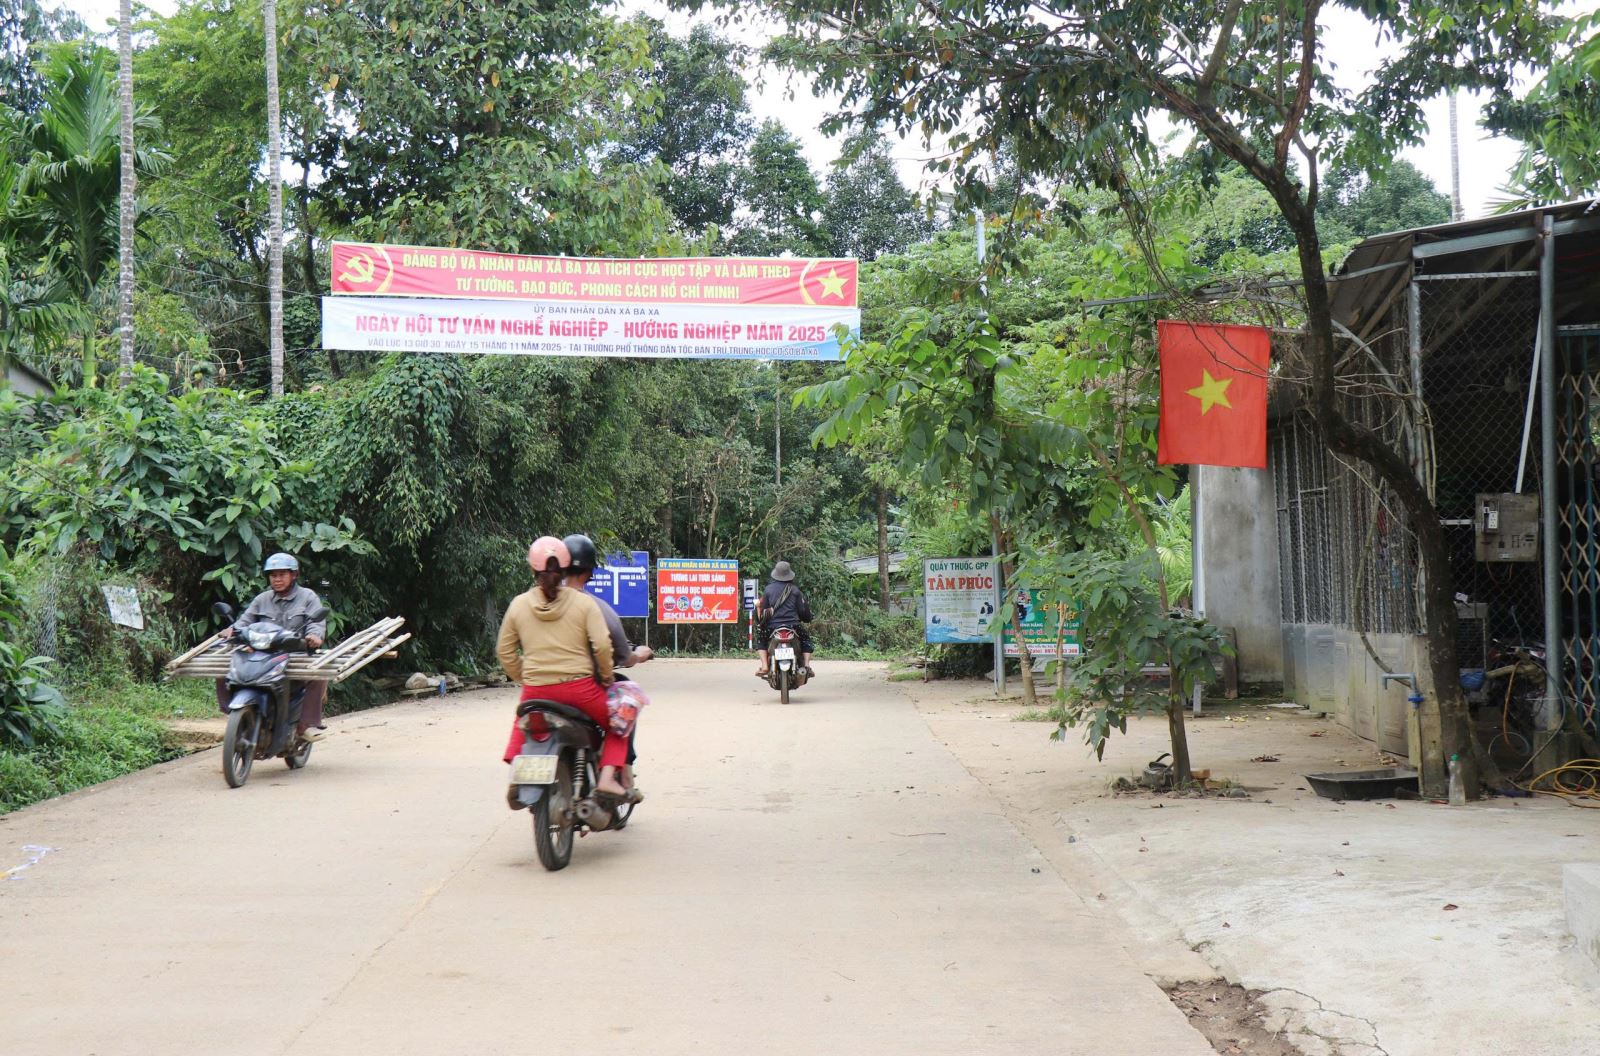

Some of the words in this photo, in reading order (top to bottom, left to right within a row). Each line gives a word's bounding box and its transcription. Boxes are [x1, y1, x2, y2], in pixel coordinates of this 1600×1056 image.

[403, 250, 437, 268] ĐẢNG
[440, 252, 457, 272] BỘ
[461, 254, 476, 270] VÀ
[480, 256, 513, 272] NHÂN
[517, 257, 542, 272] DÂN
[546, 257, 562, 273] XÃ
[566, 261, 581, 274] BA
[586, 262, 601, 275] XA
[604, 259, 631, 276] TÍCH
[634, 262, 658, 279] CỰC
[661, 263, 685, 280] HỌC
[688, 262, 711, 280] TẬP
[714, 263, 729, 278] VÀ
[733, 262, 758, 278] LÀM
[761, 265, 791, 279] THEO
[456, 277, 472, 291] TƯ
[474, 274, 518, 294] TƯỞNG,
[521, 280, 546, 296] ĐẠO
[549, 279, 577, 296] ĐỨC,
[581, 282, 622, 297] PHONG
[625, 282, 657, 298] CÁCH
[661, 280, 676, 298] HỒ
[680, 283, 700, 298] CHÍ
[704, 285, 740, 299] MINH!
[534, 304, 546, 313] ỦY
[548, 306, 568, 314] BAN
[569, 305, 595, 314] NHÂN
[598, 306, 616, 315] DÂN
[619, 306, 631, 315] XÃ
[648, 308, 660, 316] XA
[356, 313, 399, 332] NGÀY
[405, 313, 432, 336] HỘI
[438, 316, 459, 334] TƯ
[462, 313, 495, 335] VẤN
[501, 315, 544, 336] NGHỀ
[549, 317, 609, 341] NGHIỆP
[624, 319, 678, 339] HƯỚNG
[683, 320, 742, 343] NGHIỆP
[746, 321, 783, 341] NĂM
[788, 325, 826, 341] 2025
[430, 340, 441, 348] 30
[445, 340, 466, 349] NGÀY
[470, 341, 479, 349] 15
[481, 340, 507, 350] THÁNG
[510, 342, 519, 350] 11
[521, 341, 539, 350] NĂM
[541, 343, 562, 351] 2025
[615, 342, 631, 353] PHỔ
[633, 344, 658, 353] THÔNG
[660, 345, 676, 353] DÂN
[729, 346, 753, 355] TRUNG
[975, 561, 989, 570] GPP
[927, 573, 956, 590] TÂM
[958, 573, 993, 590] PHÚC
